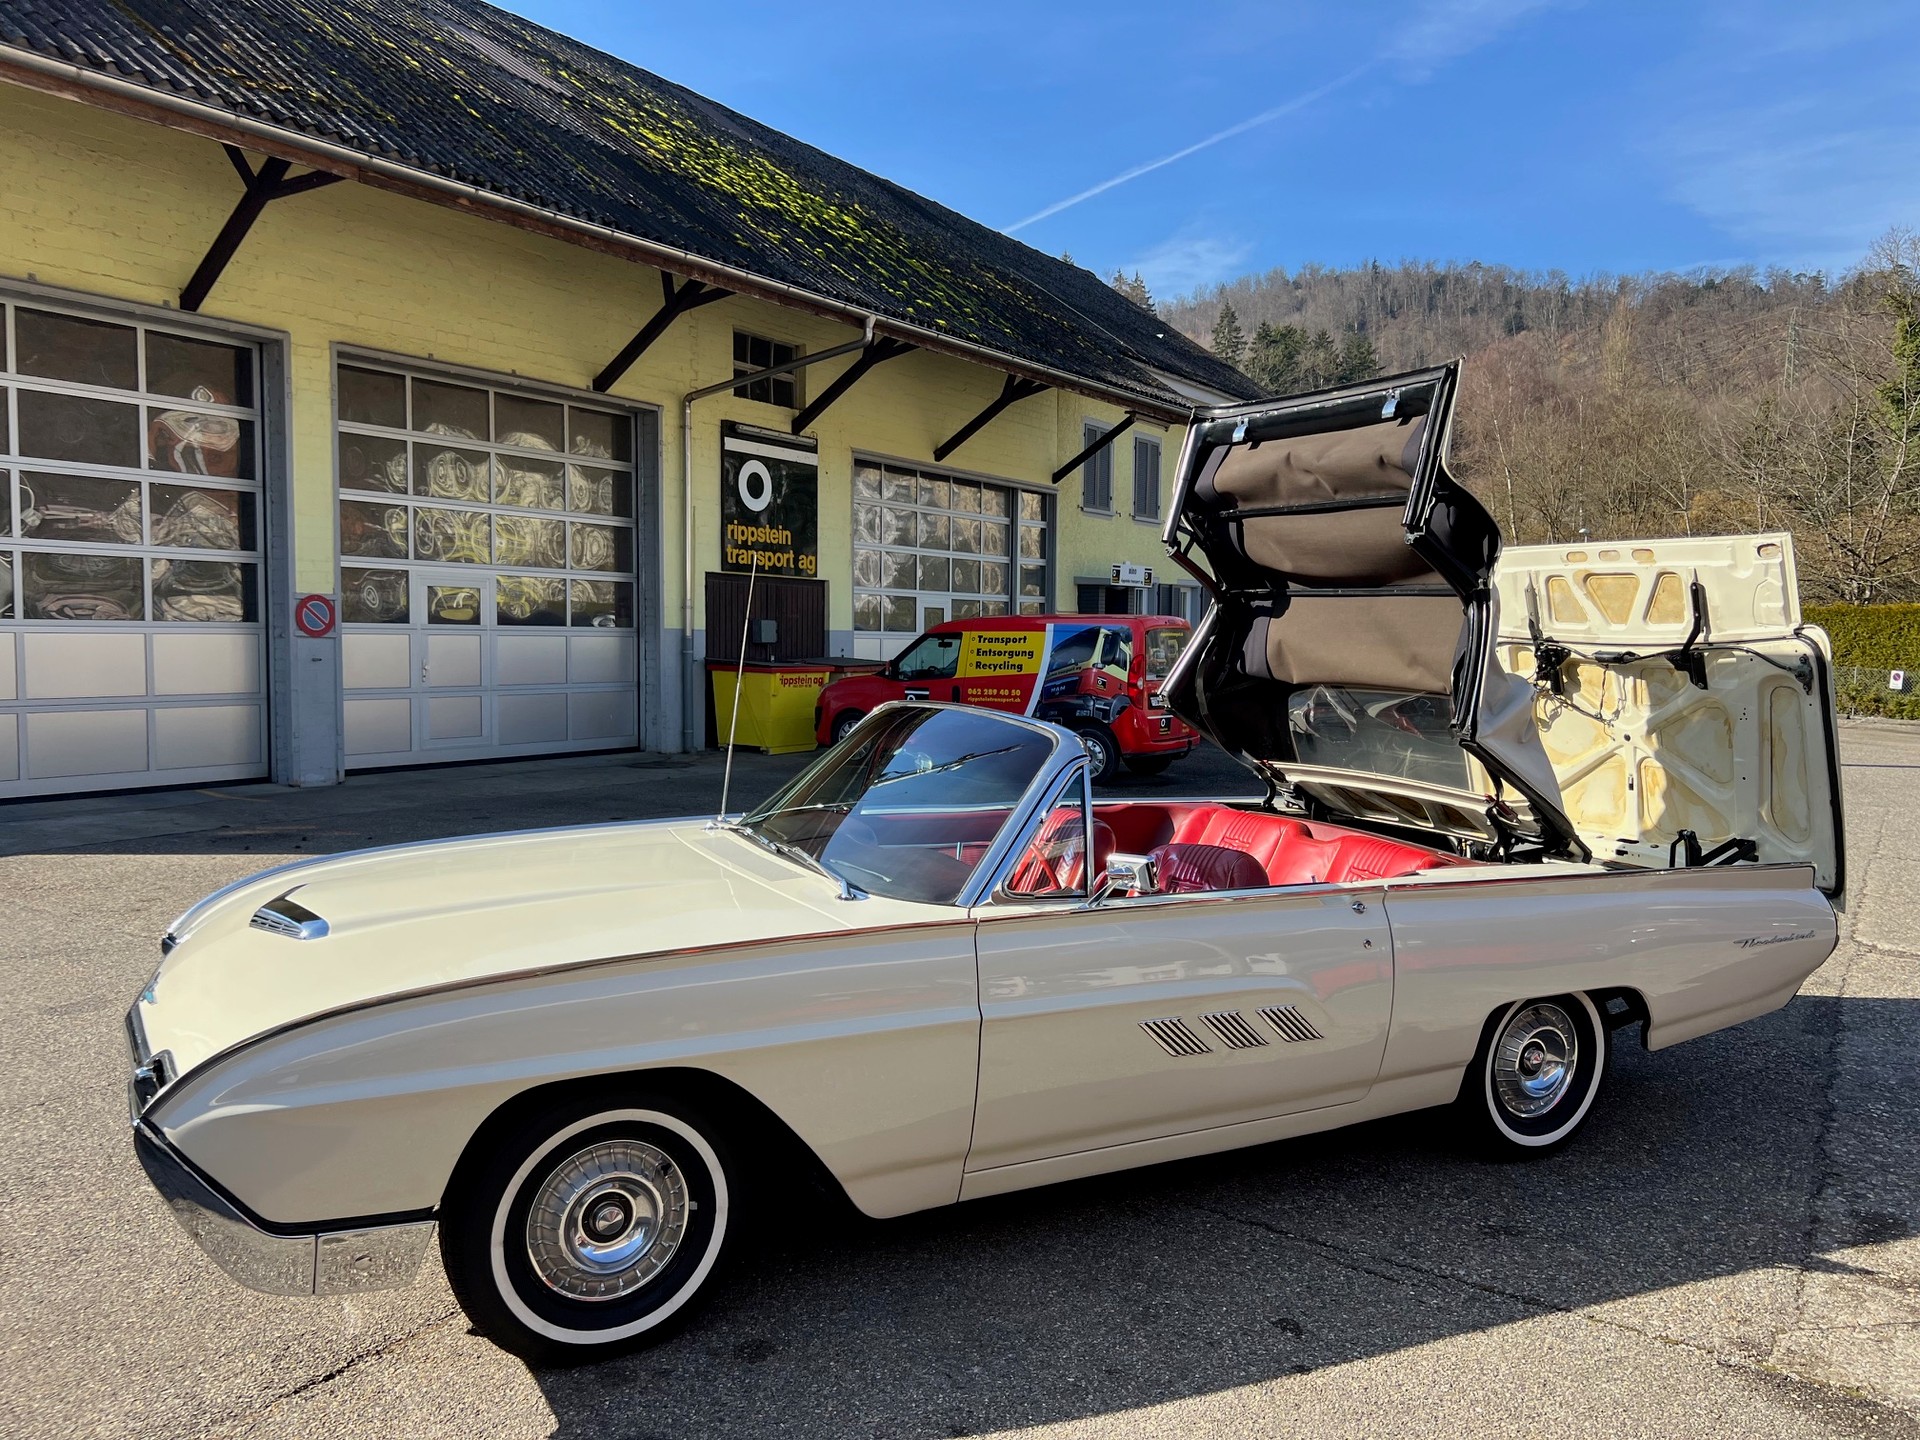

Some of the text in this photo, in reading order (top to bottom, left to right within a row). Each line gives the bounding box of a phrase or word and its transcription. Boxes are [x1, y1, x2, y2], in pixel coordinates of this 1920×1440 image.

[727, 519, 792, 546] rippstein
[726, 544, 816, 574] transport ag
[977, 635, 1027, 646] Transport
[976, 648, 1034, 659] Entsorgung
[975, 661, 1023, 672] Recycling
[813, 676, 824, 687] ag
[983, 688, 998, 696] 289
